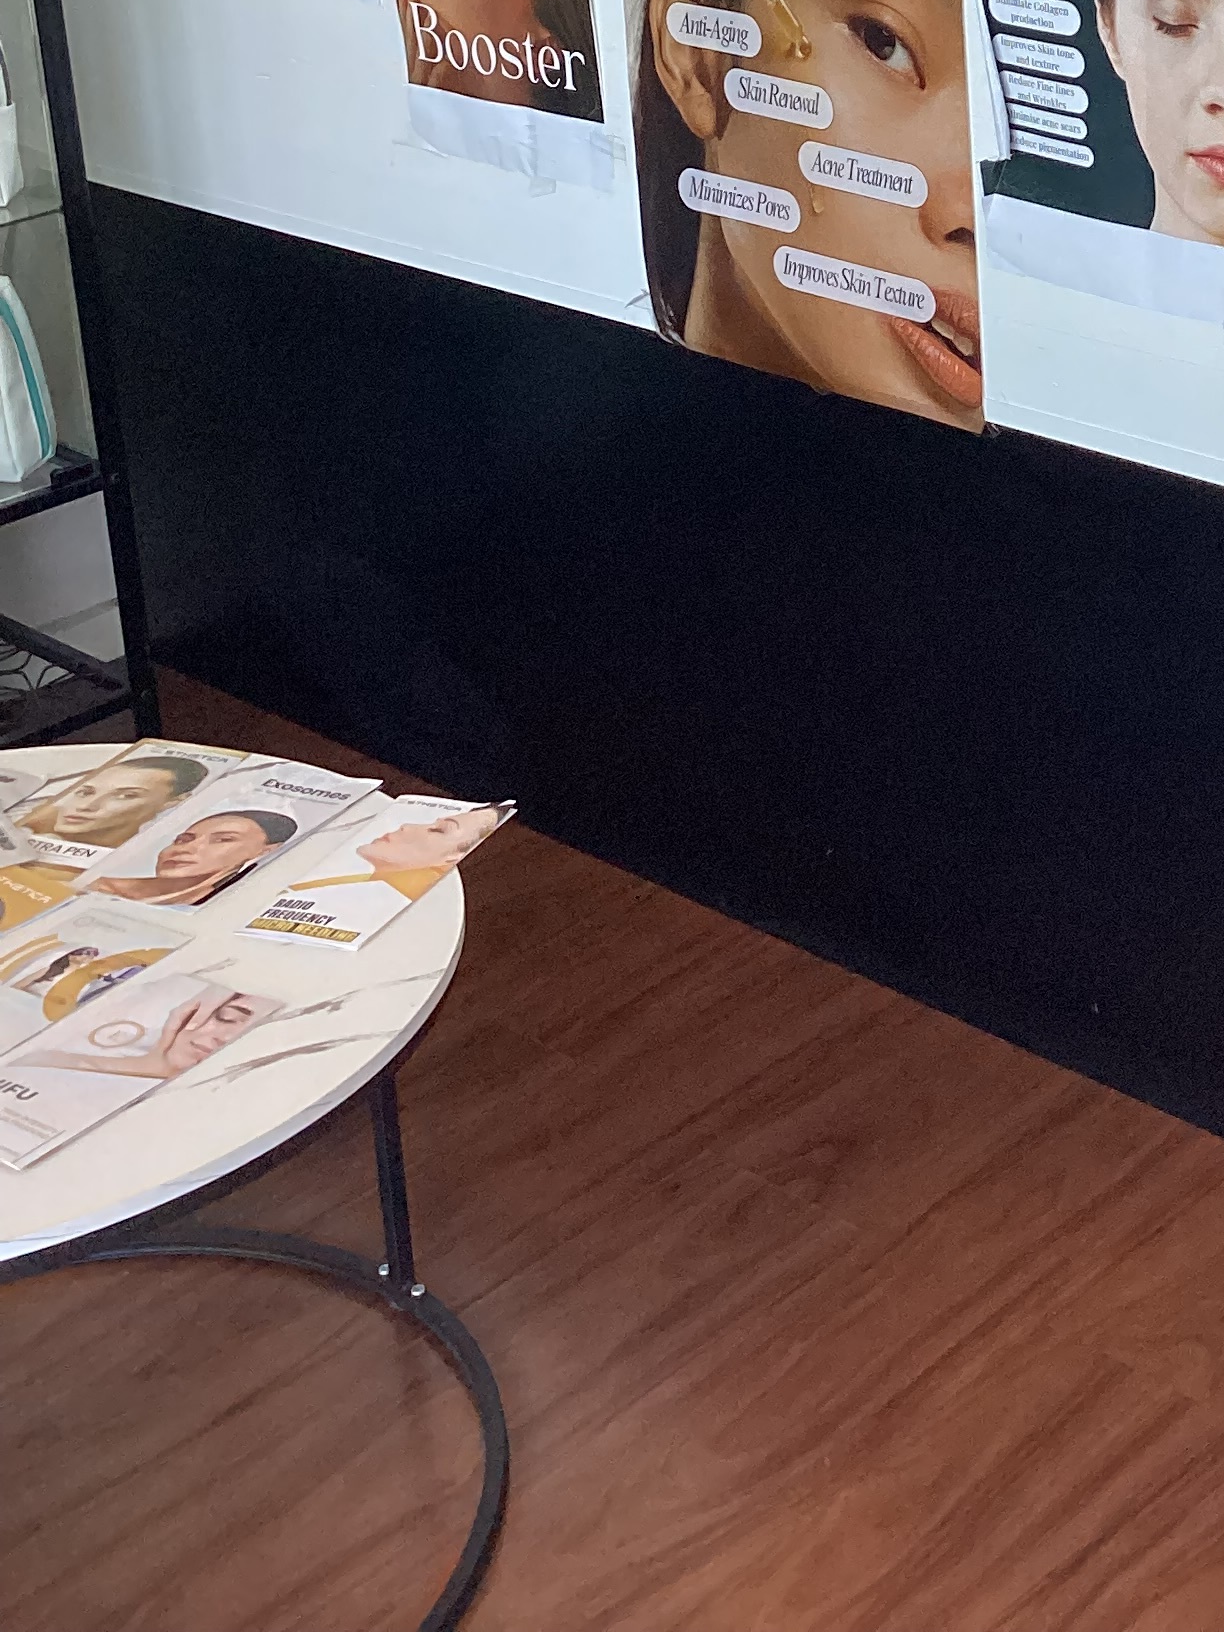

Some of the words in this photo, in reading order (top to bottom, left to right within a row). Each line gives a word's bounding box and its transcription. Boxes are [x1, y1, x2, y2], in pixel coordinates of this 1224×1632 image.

[1034, 1, 1069, 16] Collagen
[1011, 13, 1054, 28] production
[679, 12, 748, 52] Anti-Aging
[409, 1, 585, 91] Booster
[1001, 36, 1035, 52] Improves
[1037, 44, 1055, 56] Skin
[1056, 48, 1075, 59] tone
[1031, 57, 1060, 71] texture
[737, 76, 767, 105] Skin
[769, 83, 820, 116] Renewal
[1056, 84, 1075, 96] lines
[1033, 94, 1067, 109] Wrinkles
[1061, 124, 1081, 134] scars
[1012, 135, 1037, 149] educe
[811, 151, 844, 179] Acne
[847, 158, 913, 194] Treatment
[689, 176, 754, 212] Minimizes
[755, 192, 791, 221] Pores
[783, 253, 840, 288] Improves
[840, 268, 871, 298] Skin
[874, 276, 926, 310] Texture
[261, 778, 352, 801] Exosomes
[63, 846, 99, 858] PEN
[272, 898, 316, 910] RADIO
[260, 908, 336, 926] FREQUENCY
[250, 918, 294, 932] MICRO
[295, 923, 359, 942] NEEDLING
